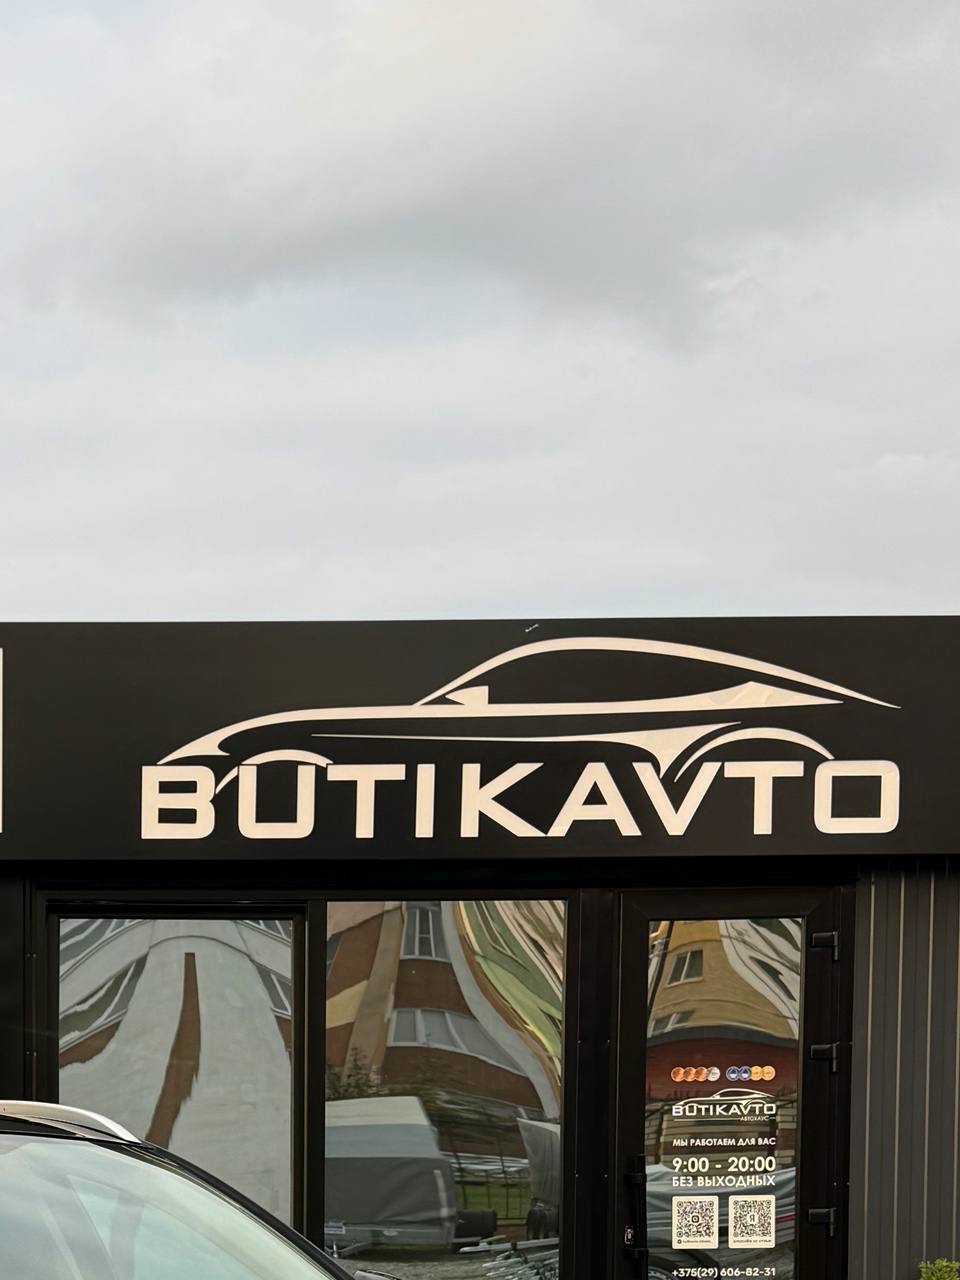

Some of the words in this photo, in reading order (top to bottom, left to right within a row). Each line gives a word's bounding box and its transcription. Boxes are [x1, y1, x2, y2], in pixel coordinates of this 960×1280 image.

[141, 760, 900, 840] BUTIKAVTO
[672, 1104, 776, 1116] BUTIKAVTO
[673, 1138, 688, 1147] МЫ
[690, 1138, 735, 1147] РАБОТАЕМ
[737, 1138, 756, 1146] ДЛЯ
[758, 1137, 776, 1146] ВАС
[672, 1157, 709, 1172] 9:00
[728, 1156, 776, 1172] 20:00
[672, 1177, 693, 1187] БЕЗ
[696, 1175, 776, 1188] ВЫХОДНЫХ
[672, 1268, 718, 1278] +375(29)
[720, 1268, 776, 1277] 606-82-31
